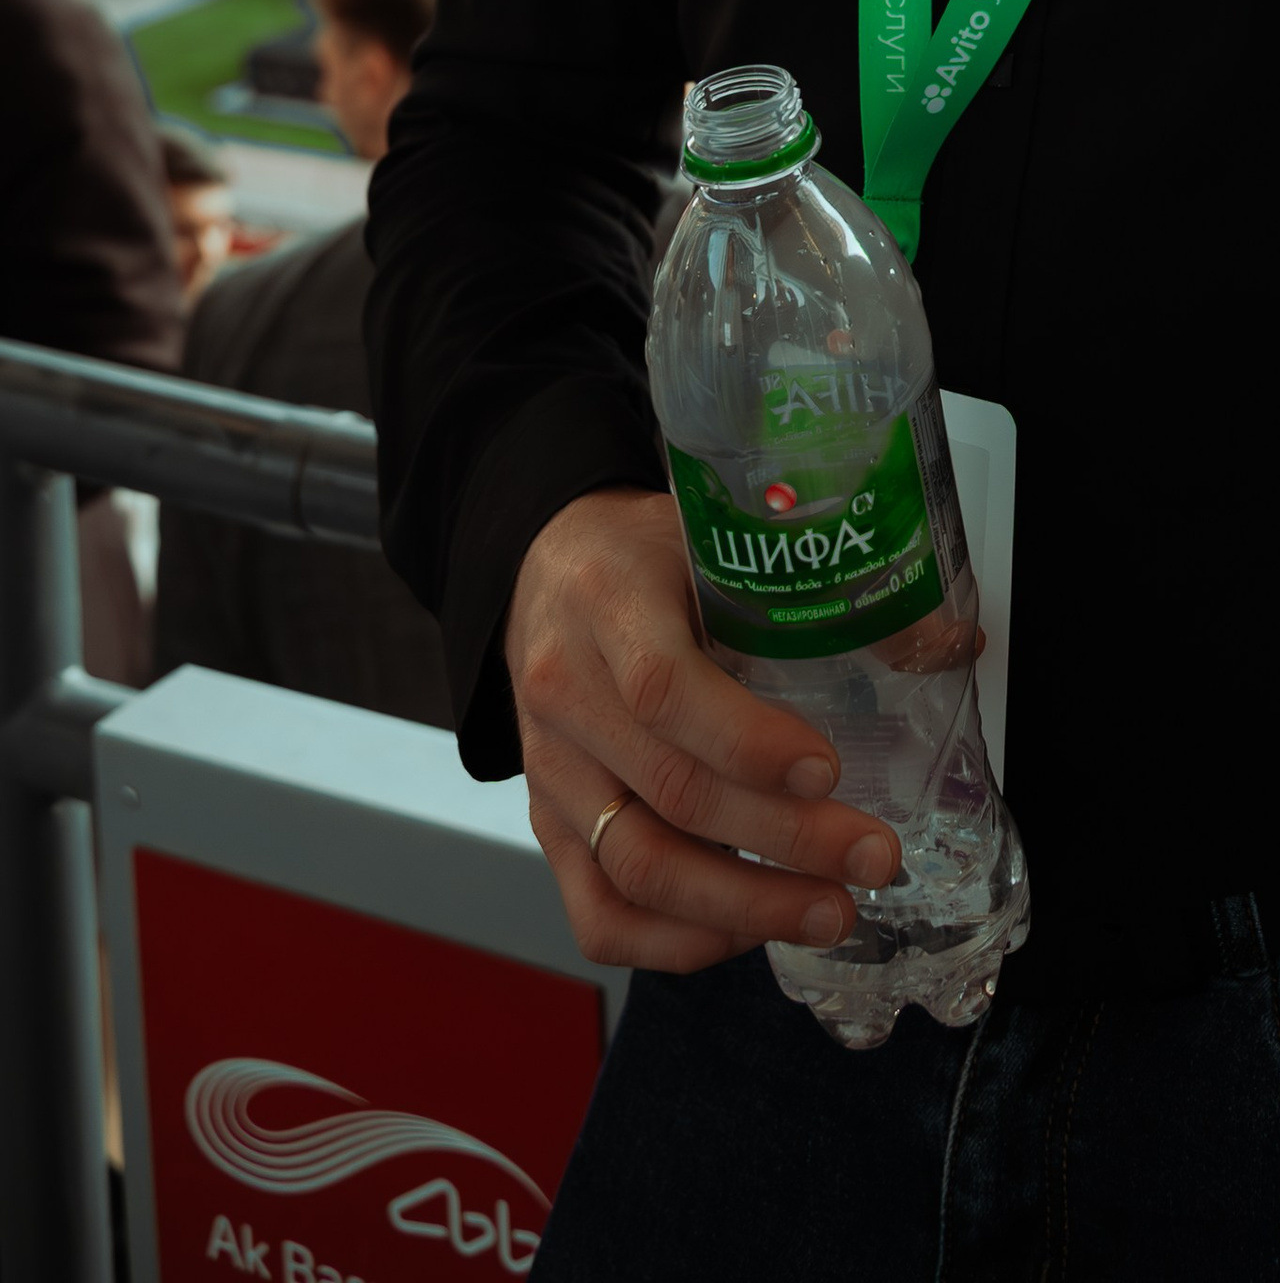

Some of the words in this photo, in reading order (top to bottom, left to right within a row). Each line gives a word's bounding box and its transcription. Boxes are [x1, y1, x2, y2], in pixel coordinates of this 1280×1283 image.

[935, 10, 990, 87] Avito
[711, 518, 876, 575] ШИФА
[851, 488, 875, 516] СУ
[795, 578, 822, 592] вода
[771, 602, 847, 623] НЕГАЗИРОВАННАЯ
